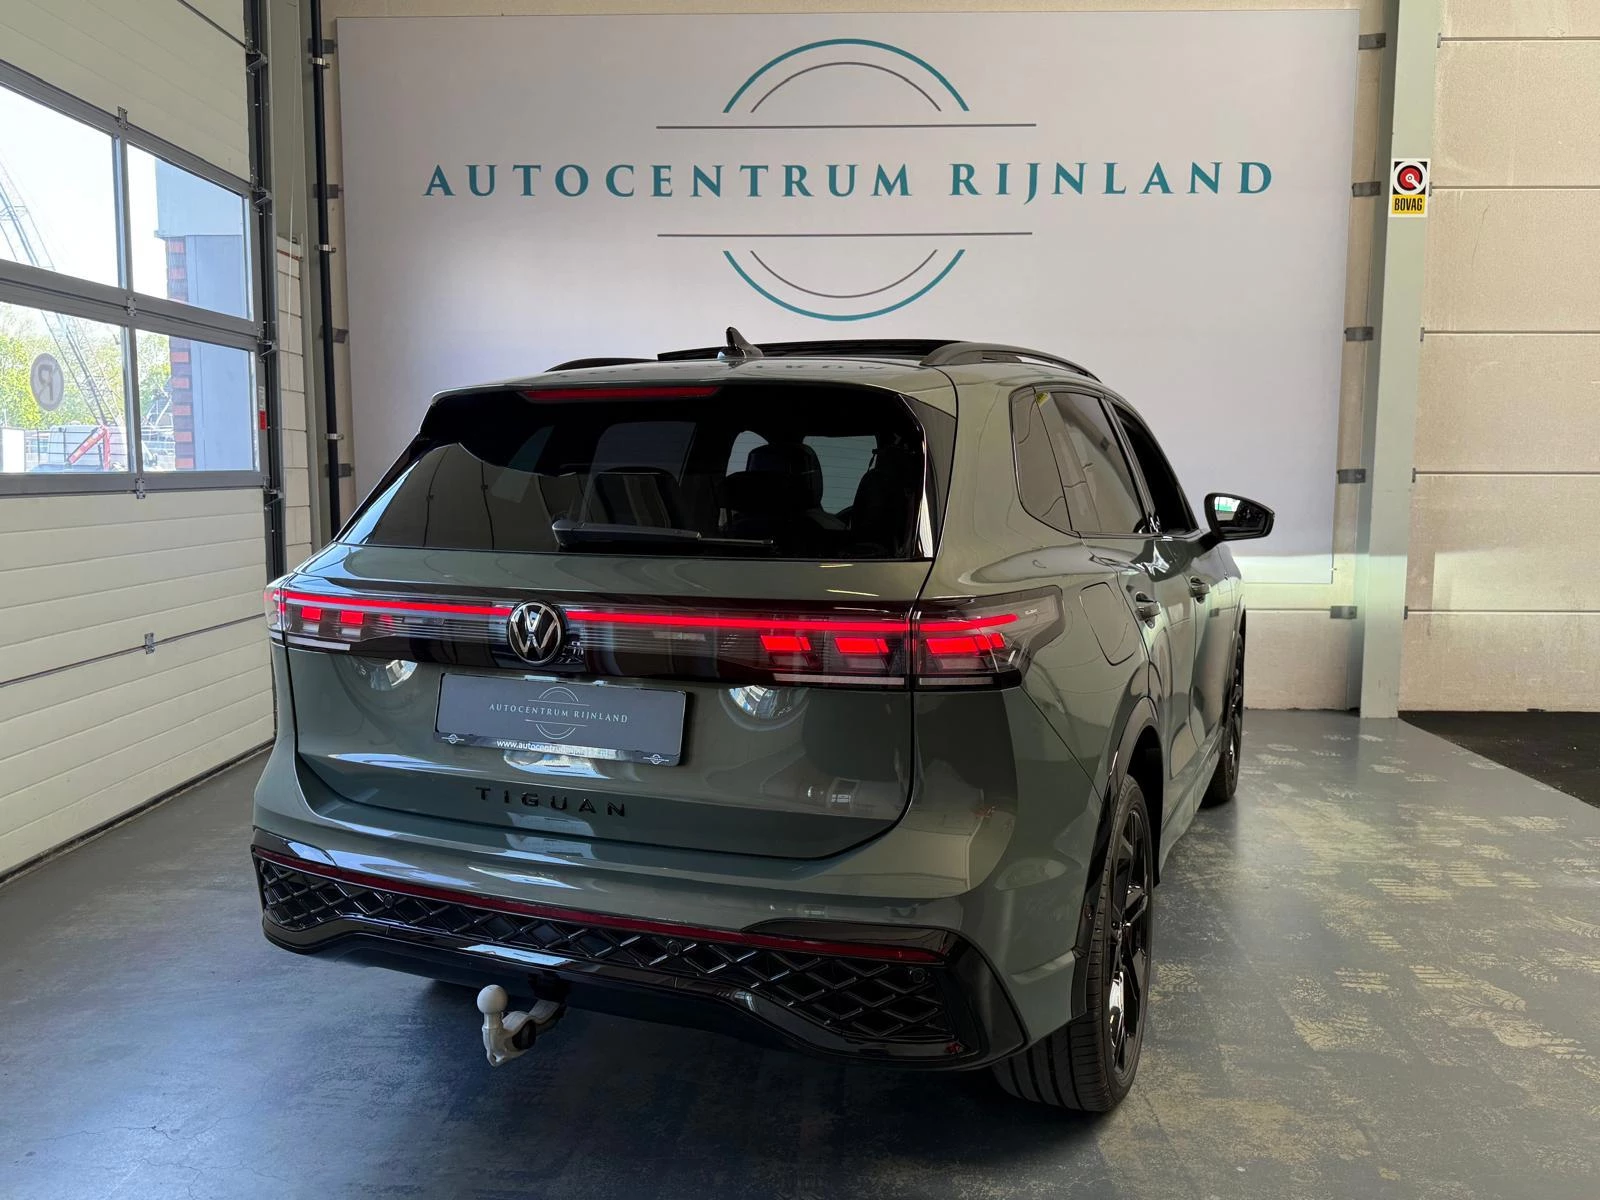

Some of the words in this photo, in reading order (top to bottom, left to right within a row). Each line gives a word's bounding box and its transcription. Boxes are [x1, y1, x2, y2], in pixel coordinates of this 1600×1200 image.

[423, 163, 913, 198] AUTOCENTRUM
[949, 161, 1272, 205] RIJNLAND
[1394, 197, 1423, 211] BOVAG
[489, 703, 569, 717] AUTOCENTRUM
[574, 710, 628, 723] RIJNLAND
[475, 786, 625, 817] TIGUAN
